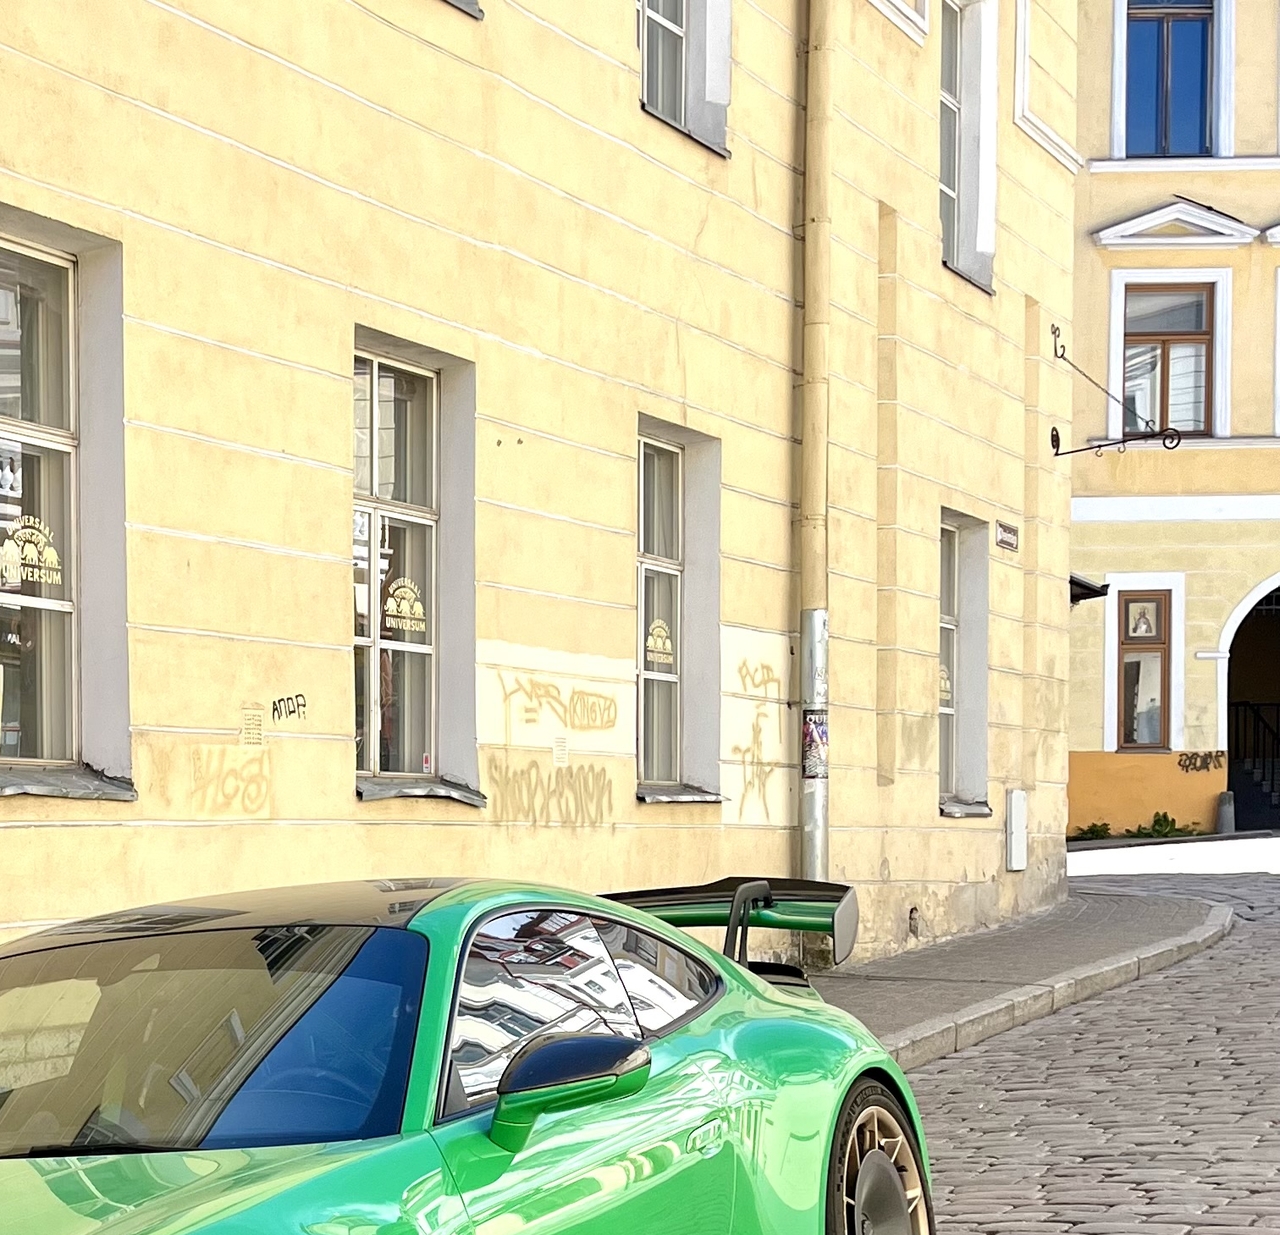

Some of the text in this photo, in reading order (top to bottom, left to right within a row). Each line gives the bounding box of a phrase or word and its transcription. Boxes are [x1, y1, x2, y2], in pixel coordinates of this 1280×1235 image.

[6, 515, 54, 543] UNIVERSAAL
[2, 563, 62, 585] UNIVERSUM
[385, 616, 426, 632] UNIVERSUM
